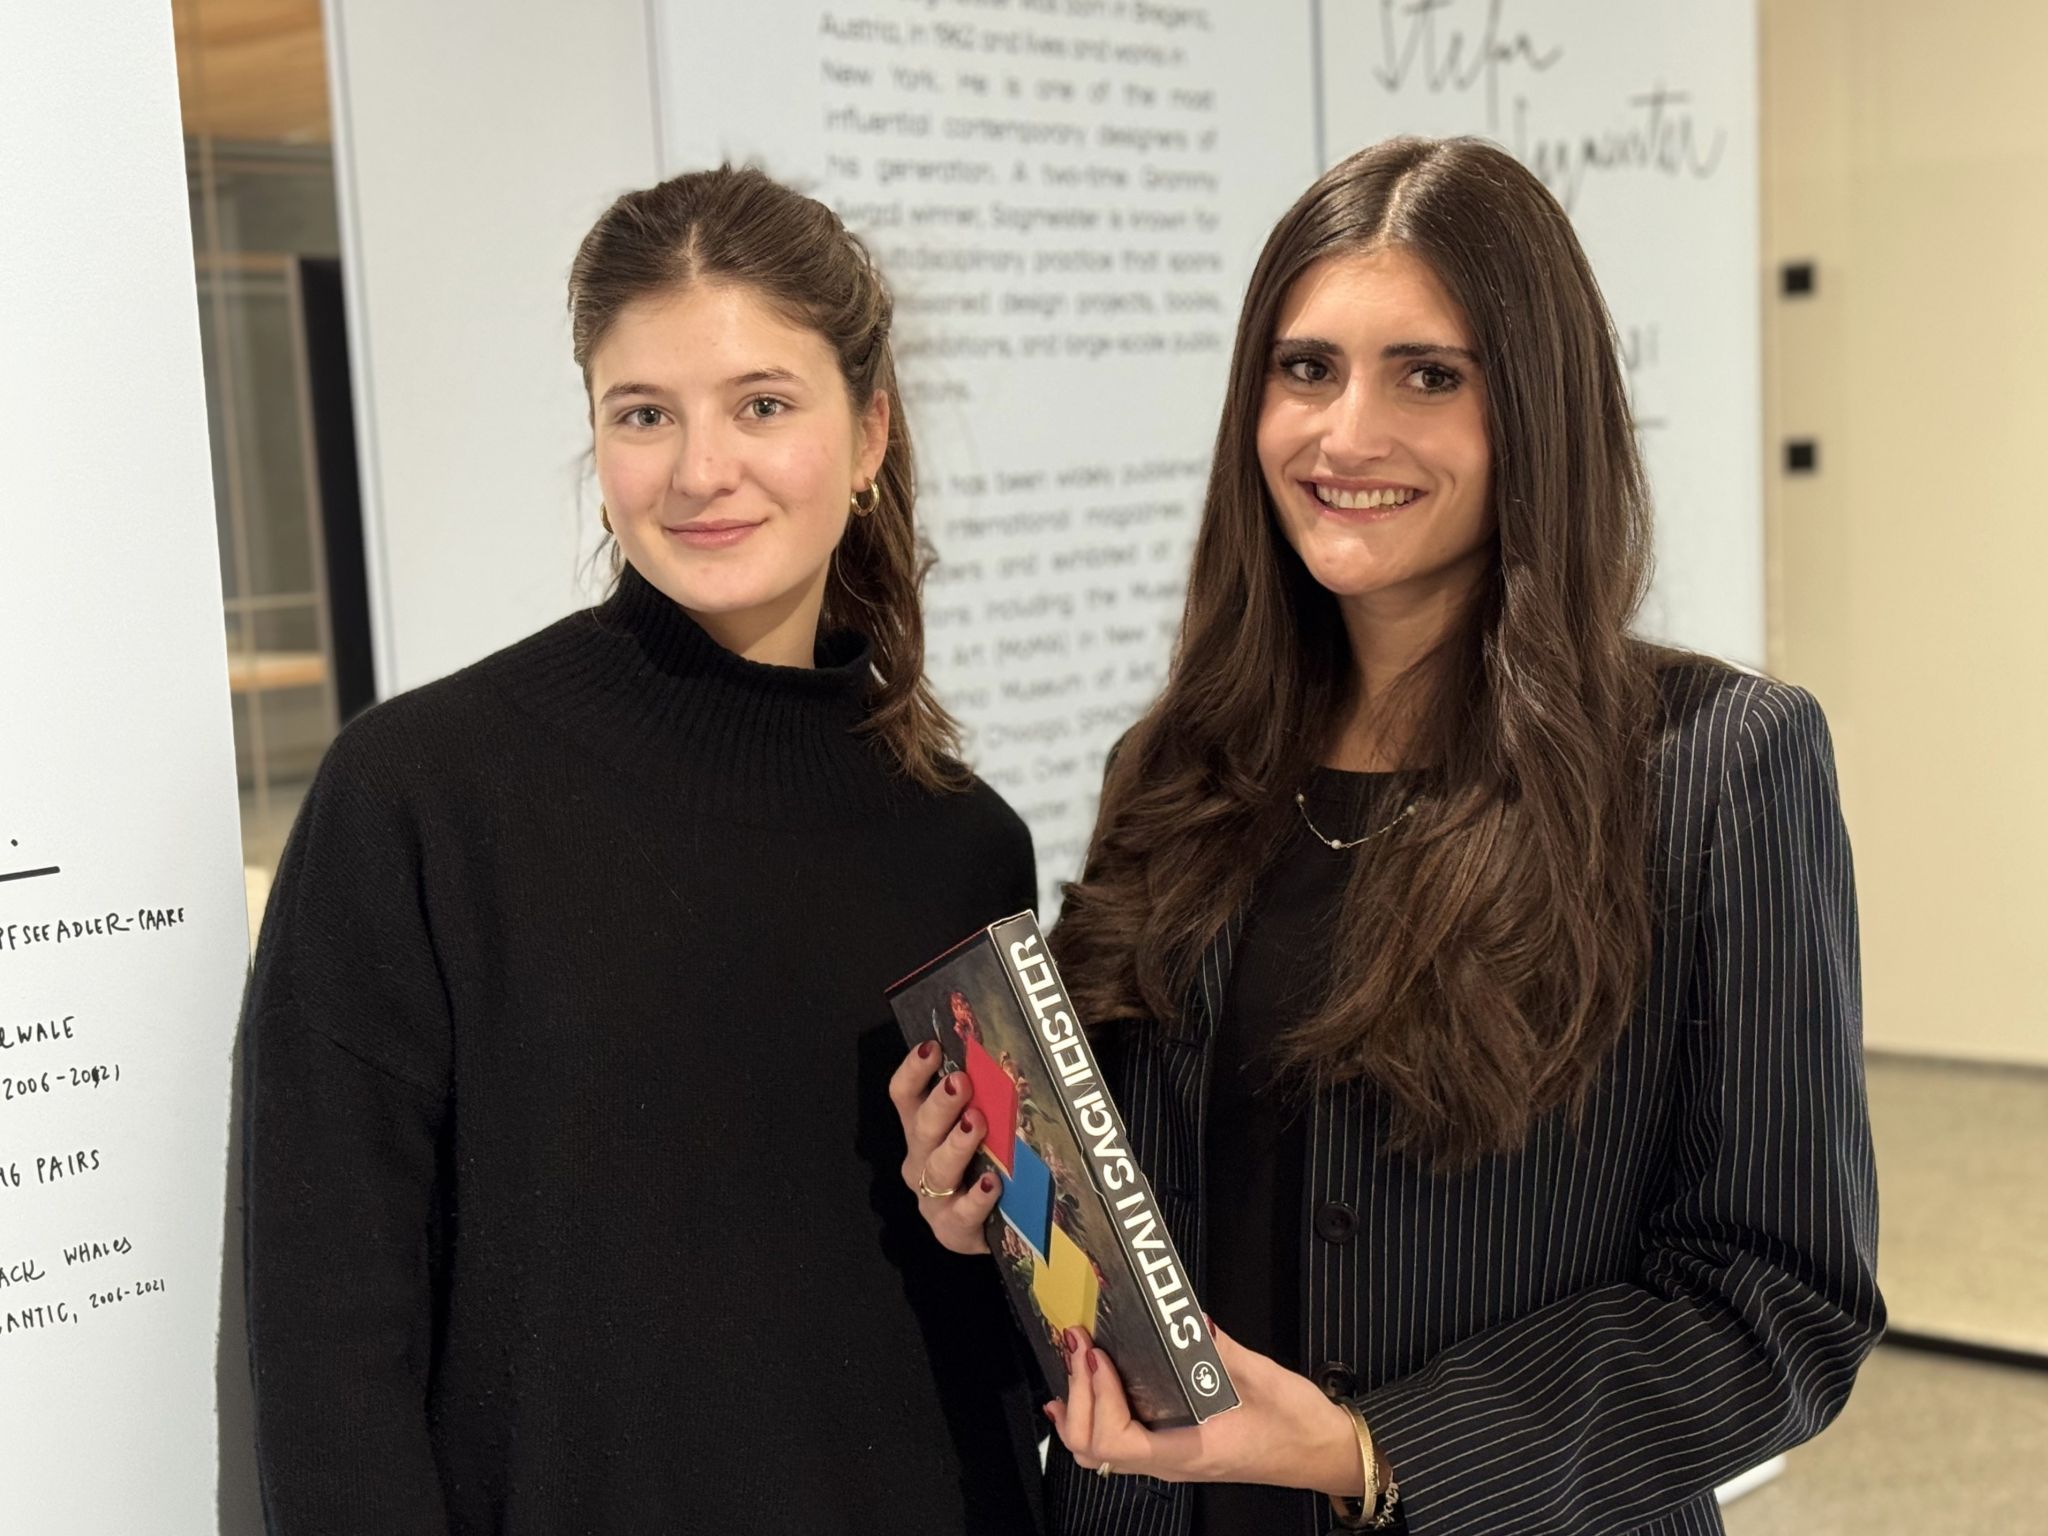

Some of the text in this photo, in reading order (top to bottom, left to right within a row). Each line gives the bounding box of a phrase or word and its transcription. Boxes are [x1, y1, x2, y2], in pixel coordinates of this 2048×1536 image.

[1008, 933, 1136, 1191] SAGMEISTER
[37, 1149, 100, 1184] PAIRS
[0, 1279, 166, 1334] ANTIC, 2006-2021
[1115, 1191, 1203, 1351] STEFAN
